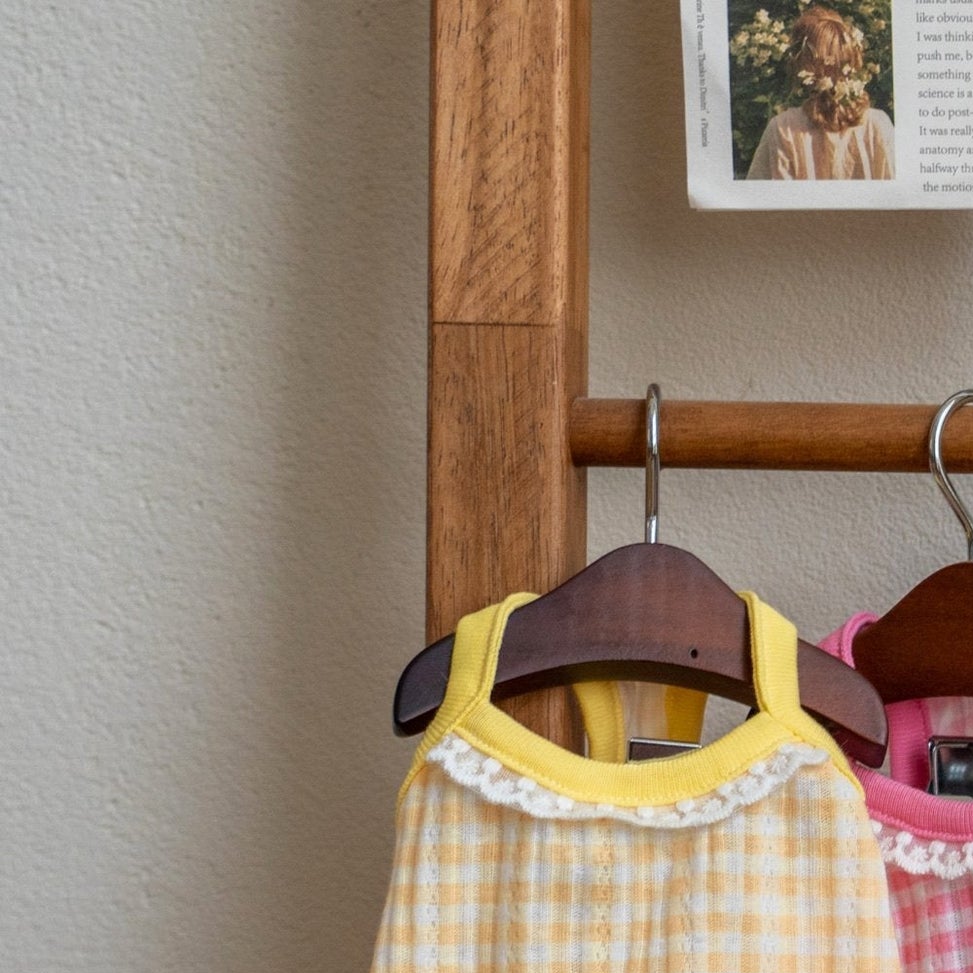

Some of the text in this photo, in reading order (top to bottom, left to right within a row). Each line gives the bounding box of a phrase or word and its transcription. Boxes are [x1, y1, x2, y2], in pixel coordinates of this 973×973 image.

[916, 11, 934, 23] like
[918, 68, 971, 82] something
[918, 88, 954, 98] science
[956, 87, 965, 98] is
[919, 125, 927, 136] It
[929, 128, 948, 136] was
[919, 146, 964, 158] anatomy
[922, 180, 939, 192] the
